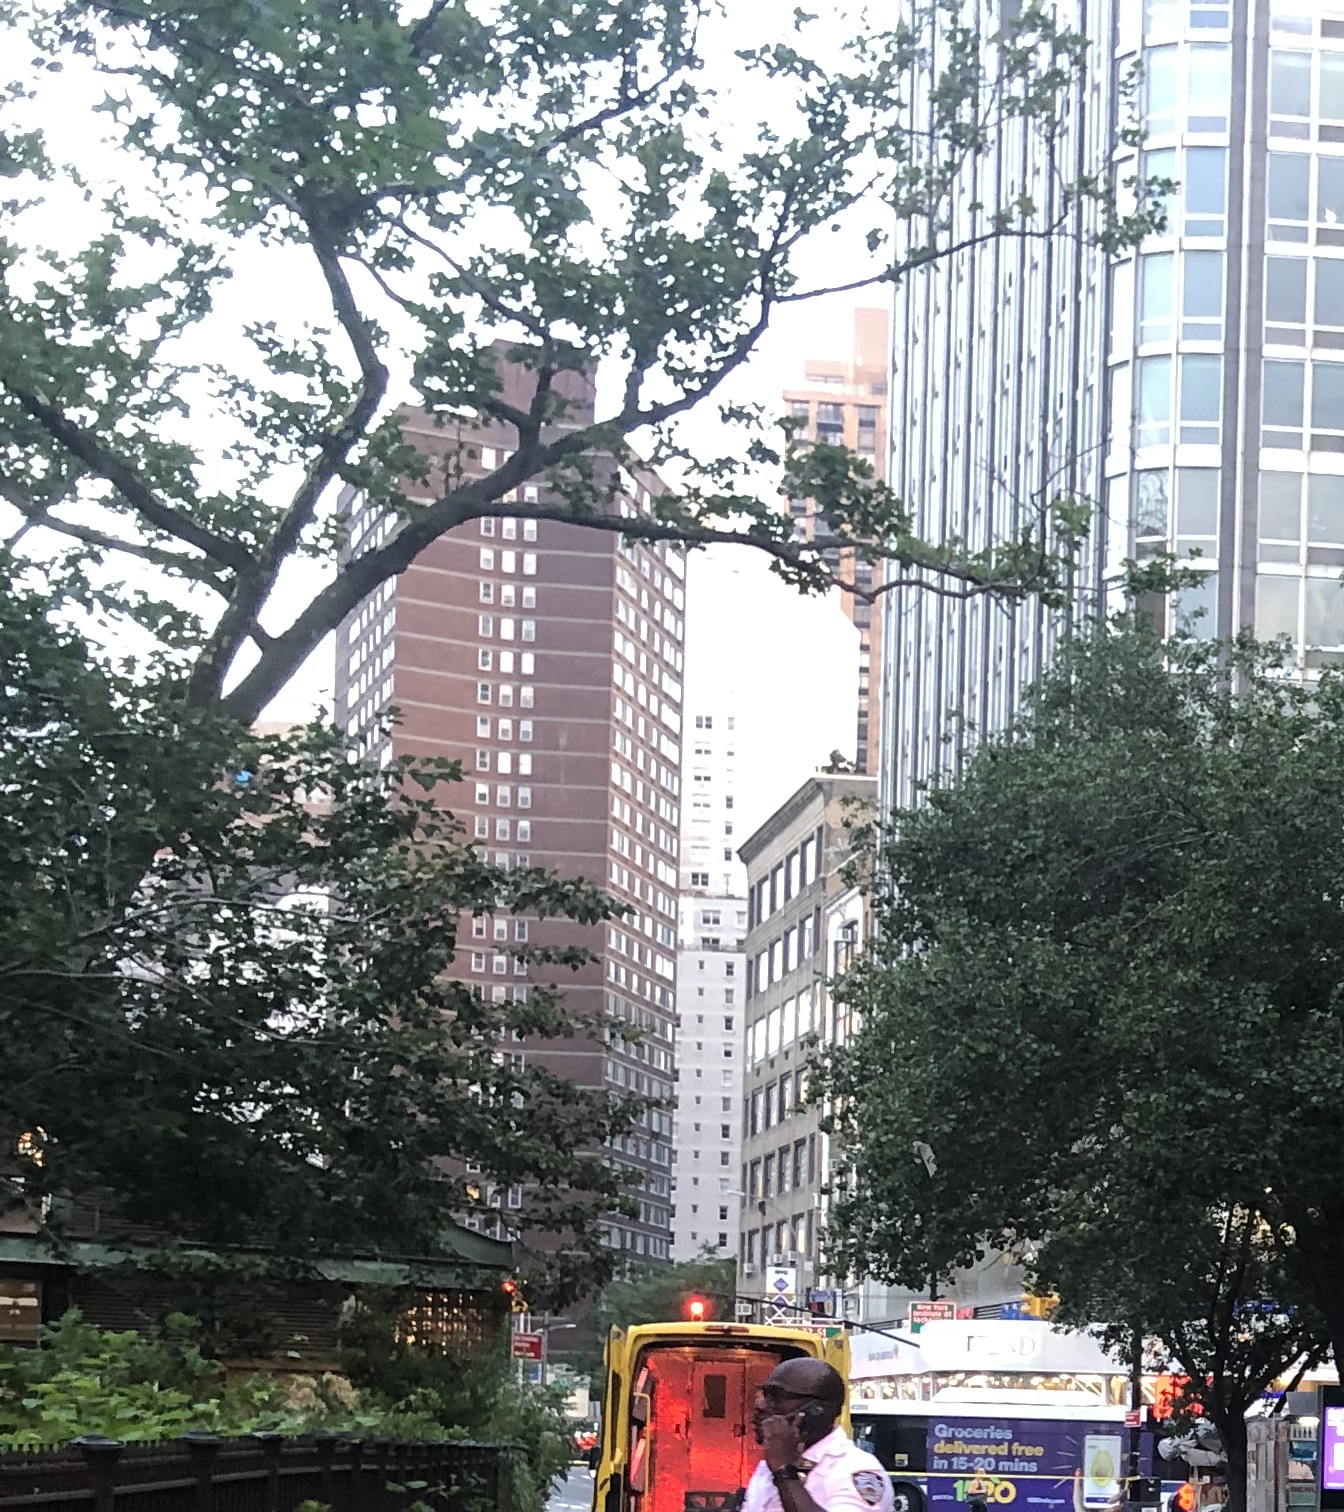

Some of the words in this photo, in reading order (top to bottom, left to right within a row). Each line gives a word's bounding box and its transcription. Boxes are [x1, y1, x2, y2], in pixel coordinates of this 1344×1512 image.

[934, 1423, 1013, 1439] Groceries
[934, 1440, 1008, 1456] delivered
[1012, 1441, 1044, 1456] free
[933, 1456, 948, 1470] in
[951, 1456, 996, 1471] 15-20
[998, 1458, 1038, 1472] mins
